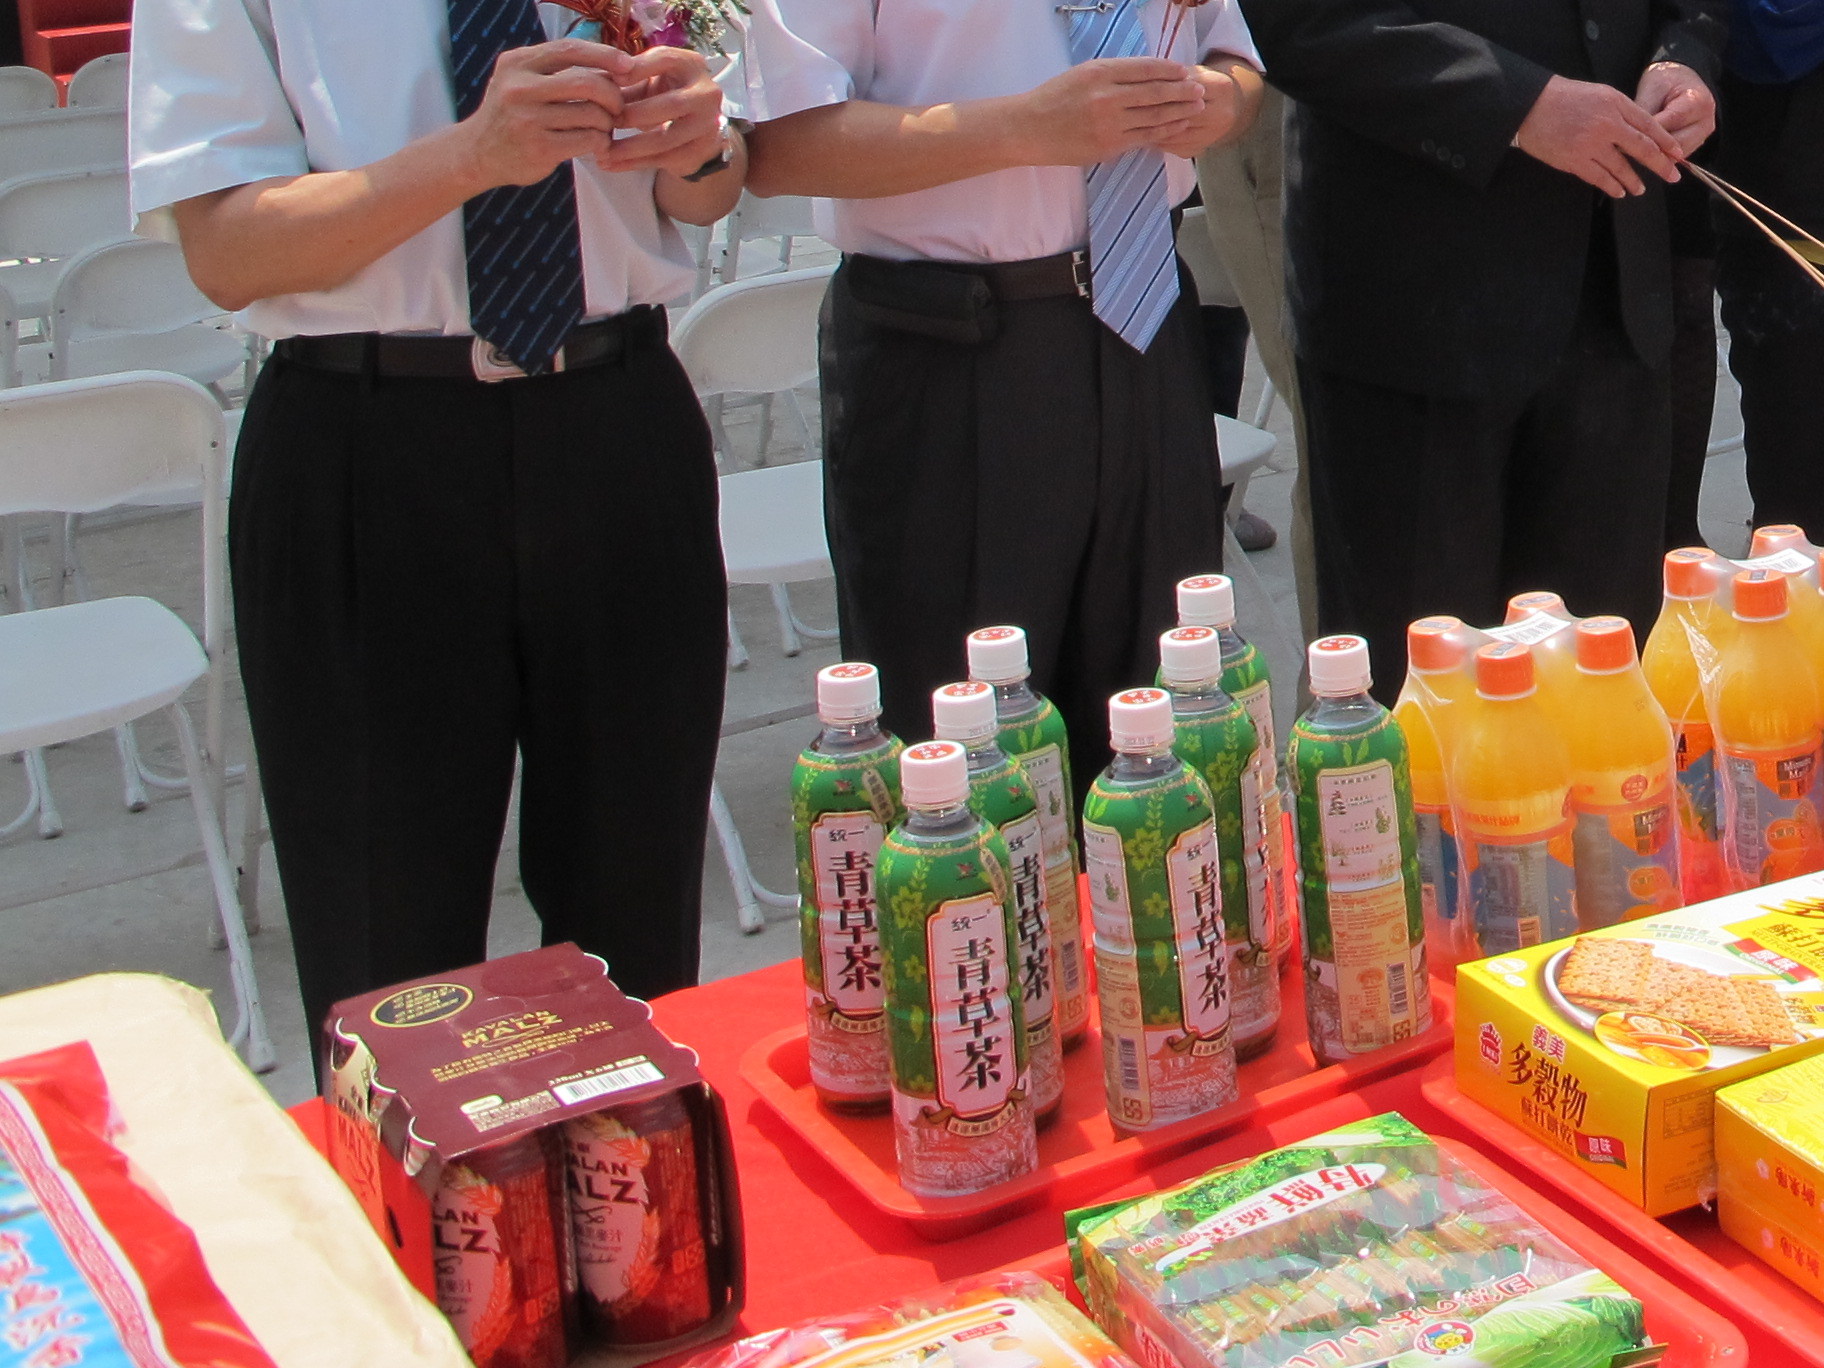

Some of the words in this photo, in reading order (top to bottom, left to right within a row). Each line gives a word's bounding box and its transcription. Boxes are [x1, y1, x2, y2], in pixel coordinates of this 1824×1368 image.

[829, 850, 882, 992] 青草茶
[1012, 854, 1051, 1002] 青草茶
[1187, 861, 1230, 1015] 青草茶
[461, 1009, 551, 1040] KAVALAN
[462, 1012, 563, 1049] MALZ
[949, 936, 1003, 1093] 青草茶
[1532, 1023, 1567, 1065] 義美
[1507, 1041, 1589, 1129] 多穀物
